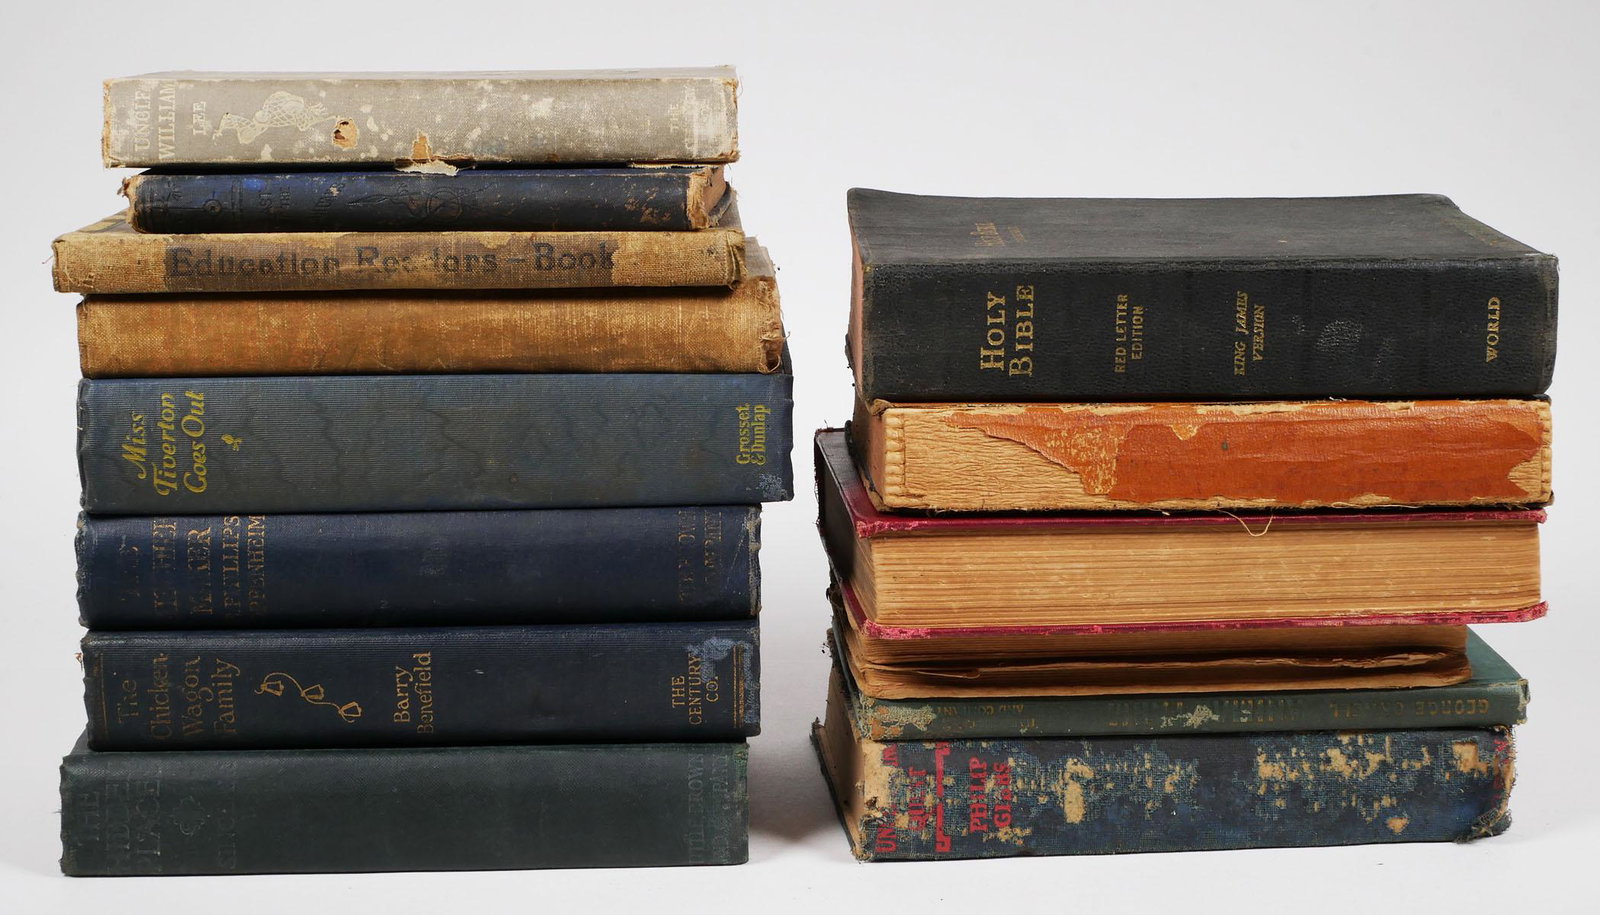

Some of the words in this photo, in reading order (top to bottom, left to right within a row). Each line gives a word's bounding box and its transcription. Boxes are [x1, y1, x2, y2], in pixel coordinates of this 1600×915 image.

[158, 81, 176, 159] WILLIAM
[193, 102, 207, 135] LEE
[168, 245, 339, 276] Education
[532, 241, 614, 270] Book
[980, 291, 1005, 371] HOLY
[1009, 285, 1034, 376] BIBLE
[1116, 294, 1128, 341] LETTER
[1132, 305, 1144, 359] EDITION
[1235, 291, 1248, 334] JAMES
[1252, 304, 1265, 362] VERSION
[1486, 296, 1500, 362] WORLD
[1114, 347, 1127, 372] RED
[1234, 341, 1246, 375] KING
[181, 390, 206, 437] Out
[751, 405, 771, 452] Dunlap
[122, 411, 147, 479] Miss
[151, 393, 178, 495] Tiverton
[183, 441, 207, 493] Goes
[751, 454, 766, 465] &
[248, 515, 265, 615] PPENHEIM
[117, 679, 140, 724] The
[182, 656, 213, 736] Wagon
[211, 659, 240, 734] Family
[394, 666, 412, 723] Barry
[413, 652, 433, 734] Benefield
[672, 675, 685, 708] THE
[688, 653, 702, 725] CENTURY
[706, 676, 719, 703] CO.
[969, 757, 988, 832] PHILIP
